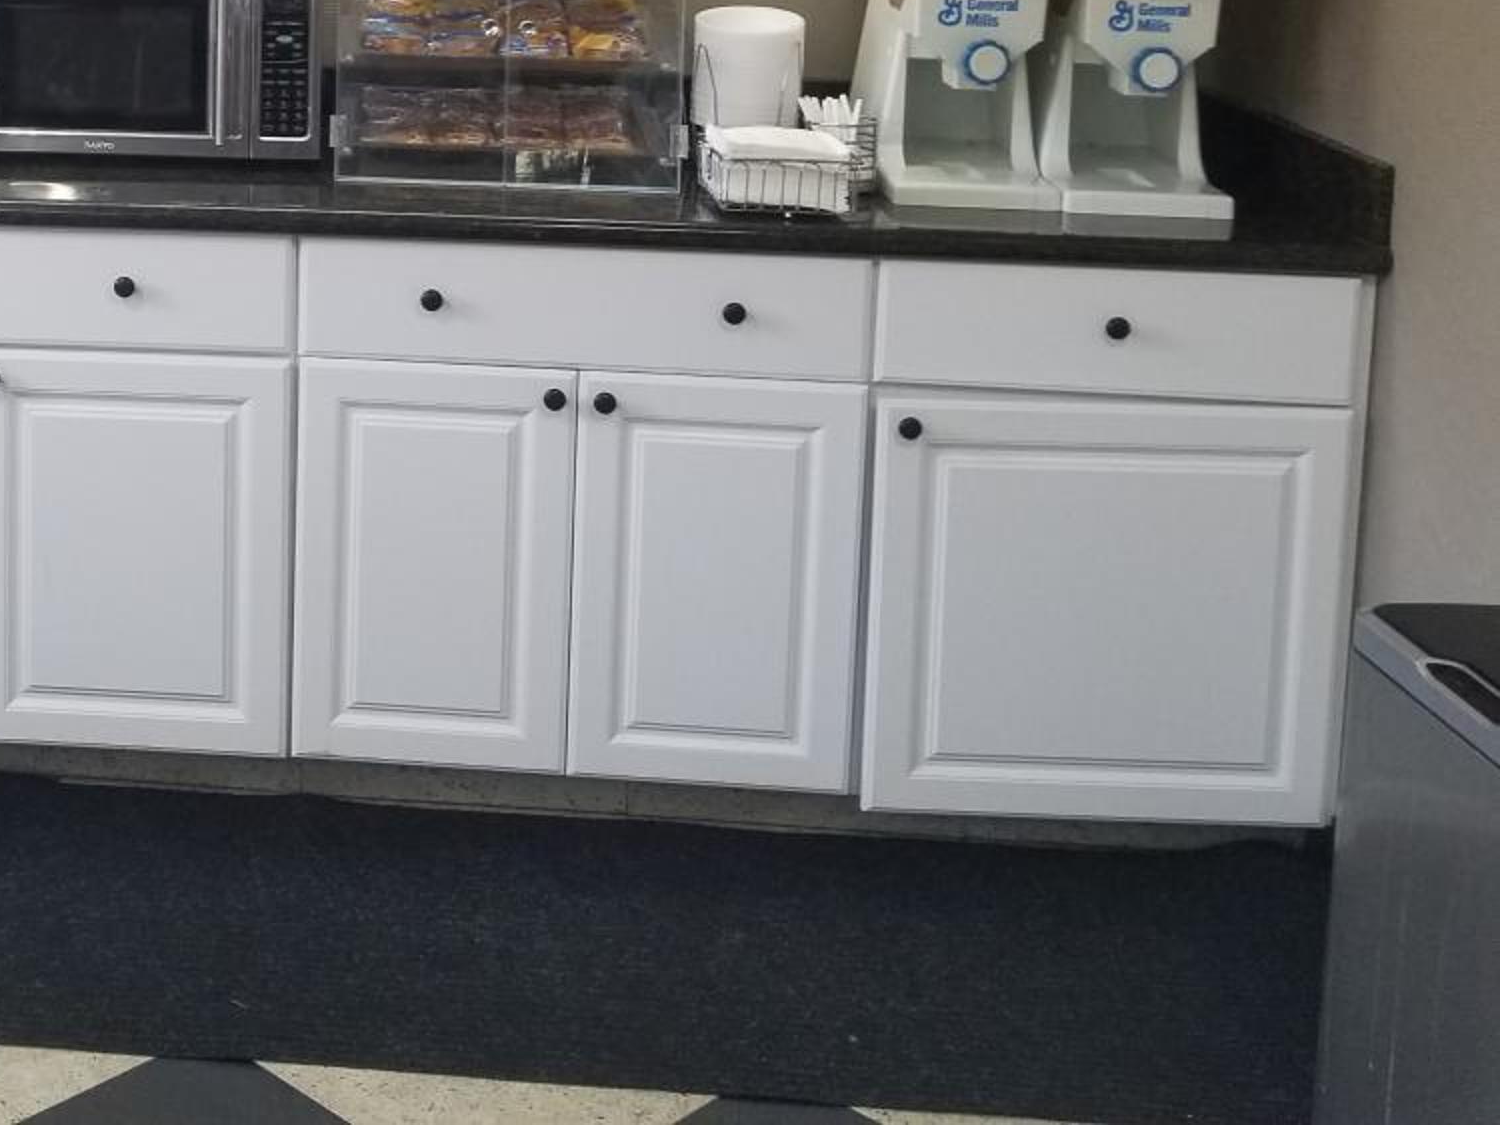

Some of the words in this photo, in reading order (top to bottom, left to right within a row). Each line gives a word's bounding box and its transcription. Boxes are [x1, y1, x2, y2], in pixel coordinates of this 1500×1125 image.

[1139, 1, 1192, 18] General
[965, 13, 1000, 28] Mills
[1137, 18, 1171, 33] Mills
